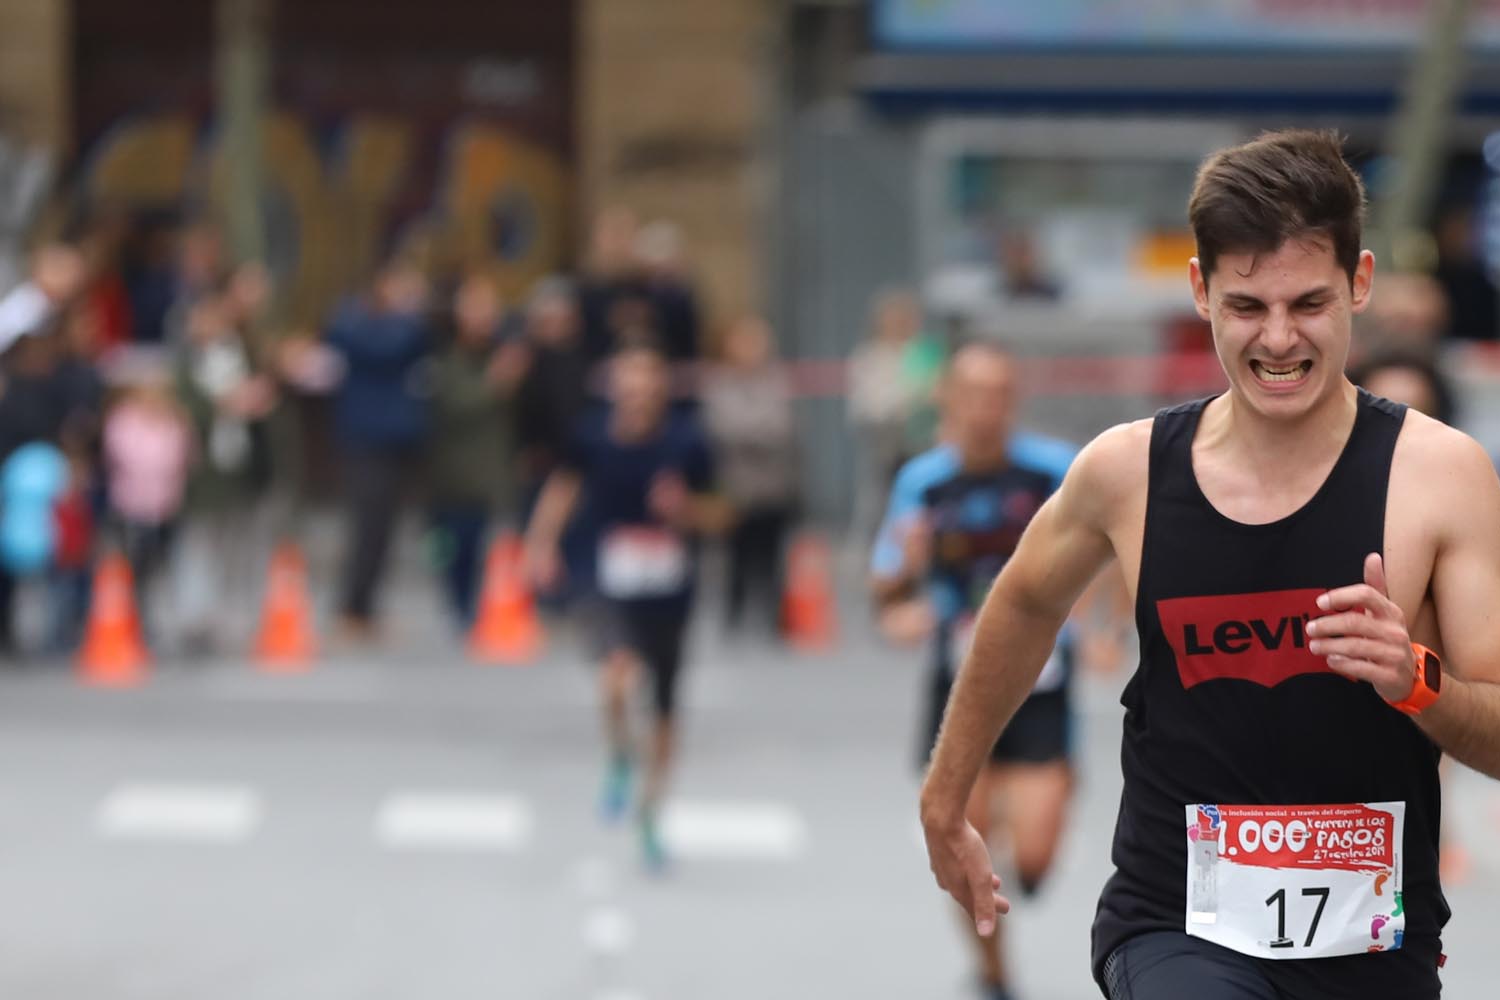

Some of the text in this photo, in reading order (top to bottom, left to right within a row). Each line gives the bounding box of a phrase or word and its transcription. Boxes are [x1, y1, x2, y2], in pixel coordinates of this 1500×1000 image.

[1183, 612, 1328, 656] Levi'
[1264, 809, 1288, 817] social
[1321, 808, 1334, 816] del
[1334, 808, 1362, 816] deporte
[1314, 819, 1353, 829] CARRERA
[1366, 817, 1386, 826] LOS
[1218, 820, 1308, 856] 1.000
[1316, 828, 1385, 849] PASOS
[1313, 849, 1328, 860] 27
[1265, 887, 1331, 949] 17
